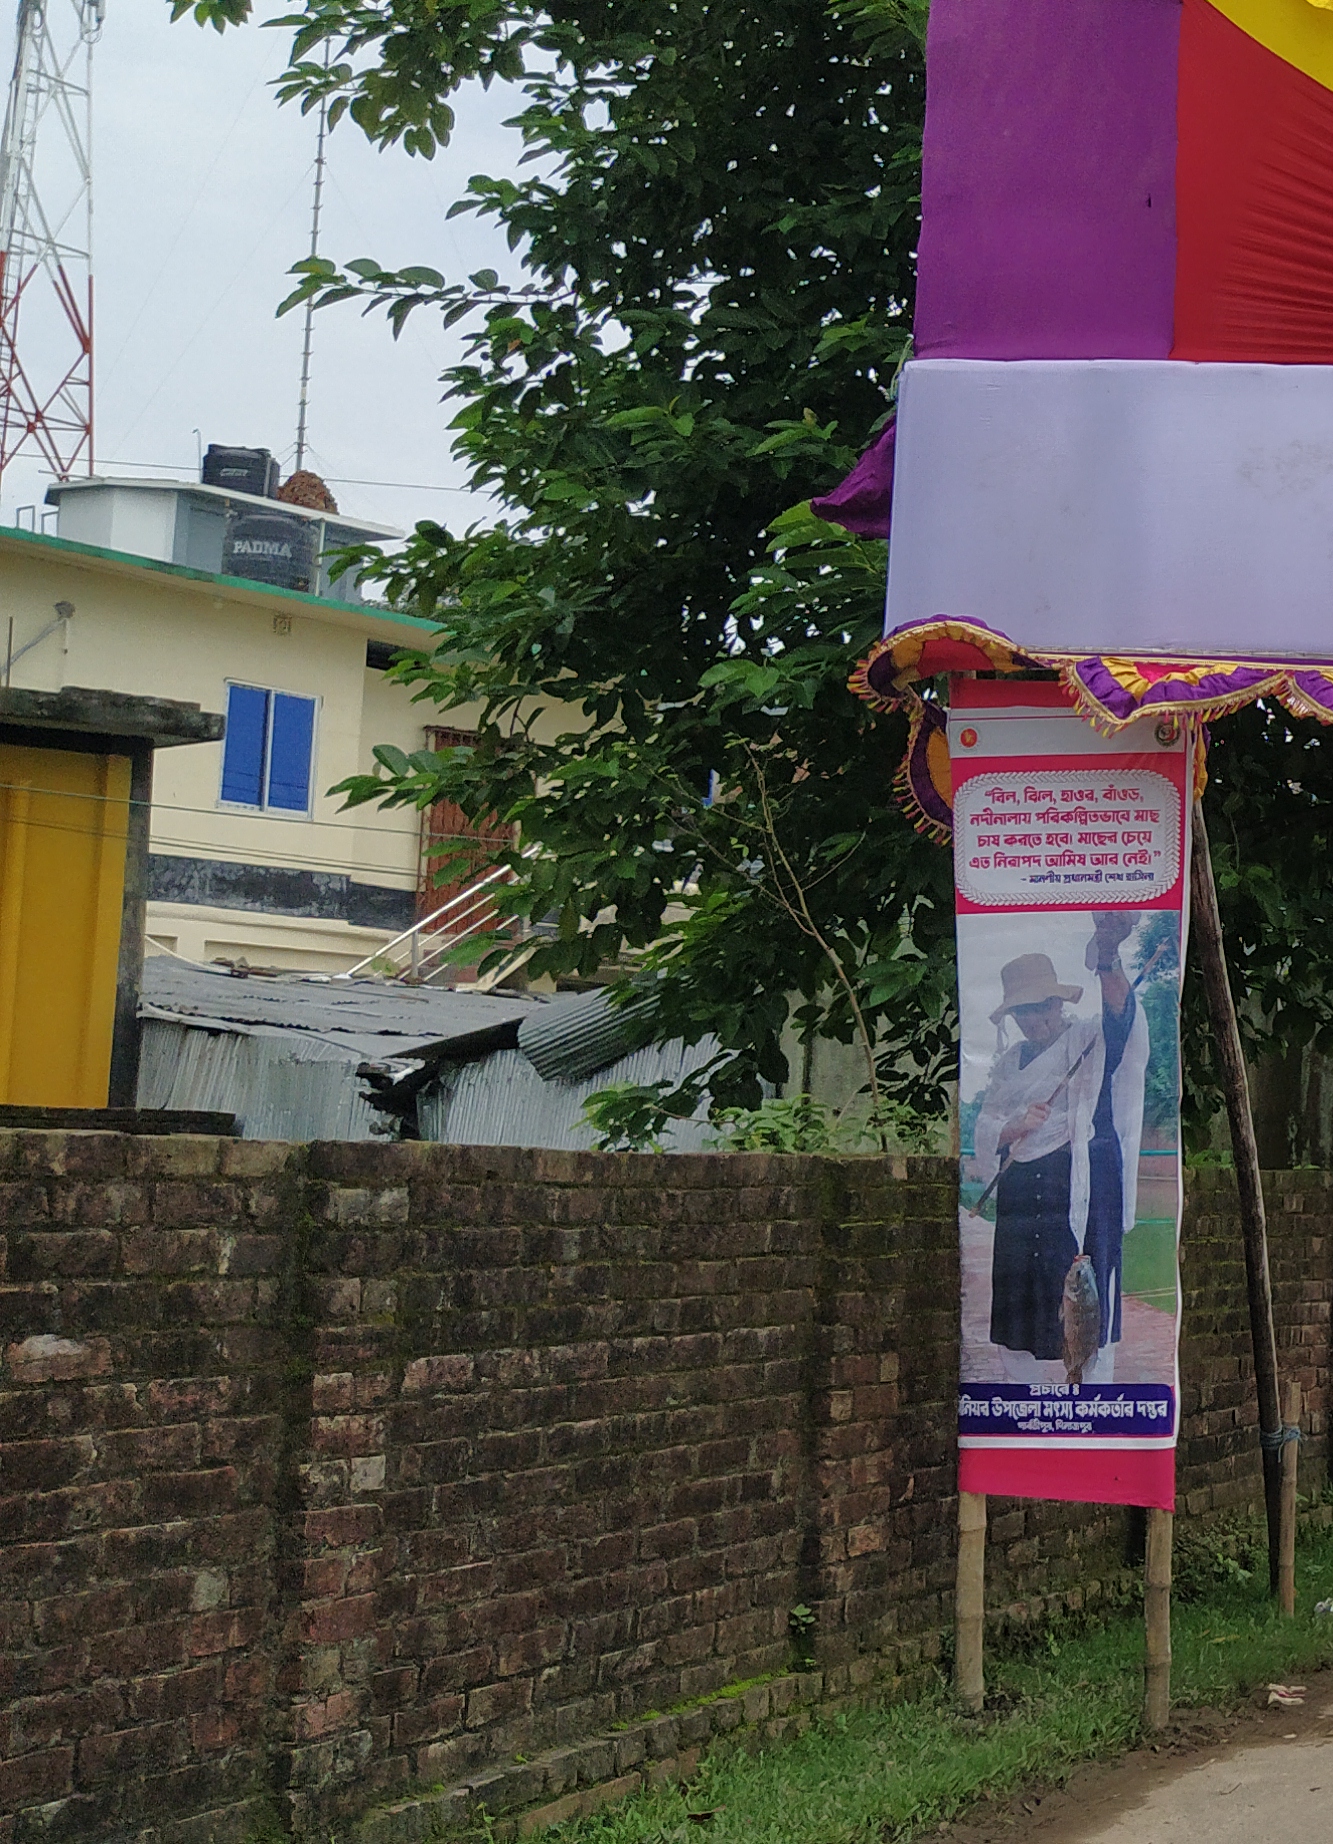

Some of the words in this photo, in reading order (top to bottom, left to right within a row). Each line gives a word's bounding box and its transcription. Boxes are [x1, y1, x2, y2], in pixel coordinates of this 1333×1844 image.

[232, 541, 293, 559] PADMA
[1035, 805, 1131, 826] পরিকল্পিতভাবে
[1134, 809, 1161, 824] মাছ
[977, 835, 1000, 848] চাষ
[1003, 834, 1042, 849] করতে
[1077, 831, 1118, 848] মাছের
[1121, 830, 1152, 847] চেয়ে
[969, 856, 990, 869] এত
[994, 851, 1041, 869] নিরাপদ
[1045, 850, 1087, 868] আমিষ
[1090, 853, 1118, 867] আর
[1029, 1384, 1070, 1396] প্রচারে
[958, 1393, 989, 1417] নিয়র
[991, 1396, 1041, 1419] উপজেলা
[1043, 1400, 1074, 1420] মৎস্য
[1075, 1393, 1134, 1418] কর্মকর্তার
[1137, 1400, 1168, 1419] দপ্তর
